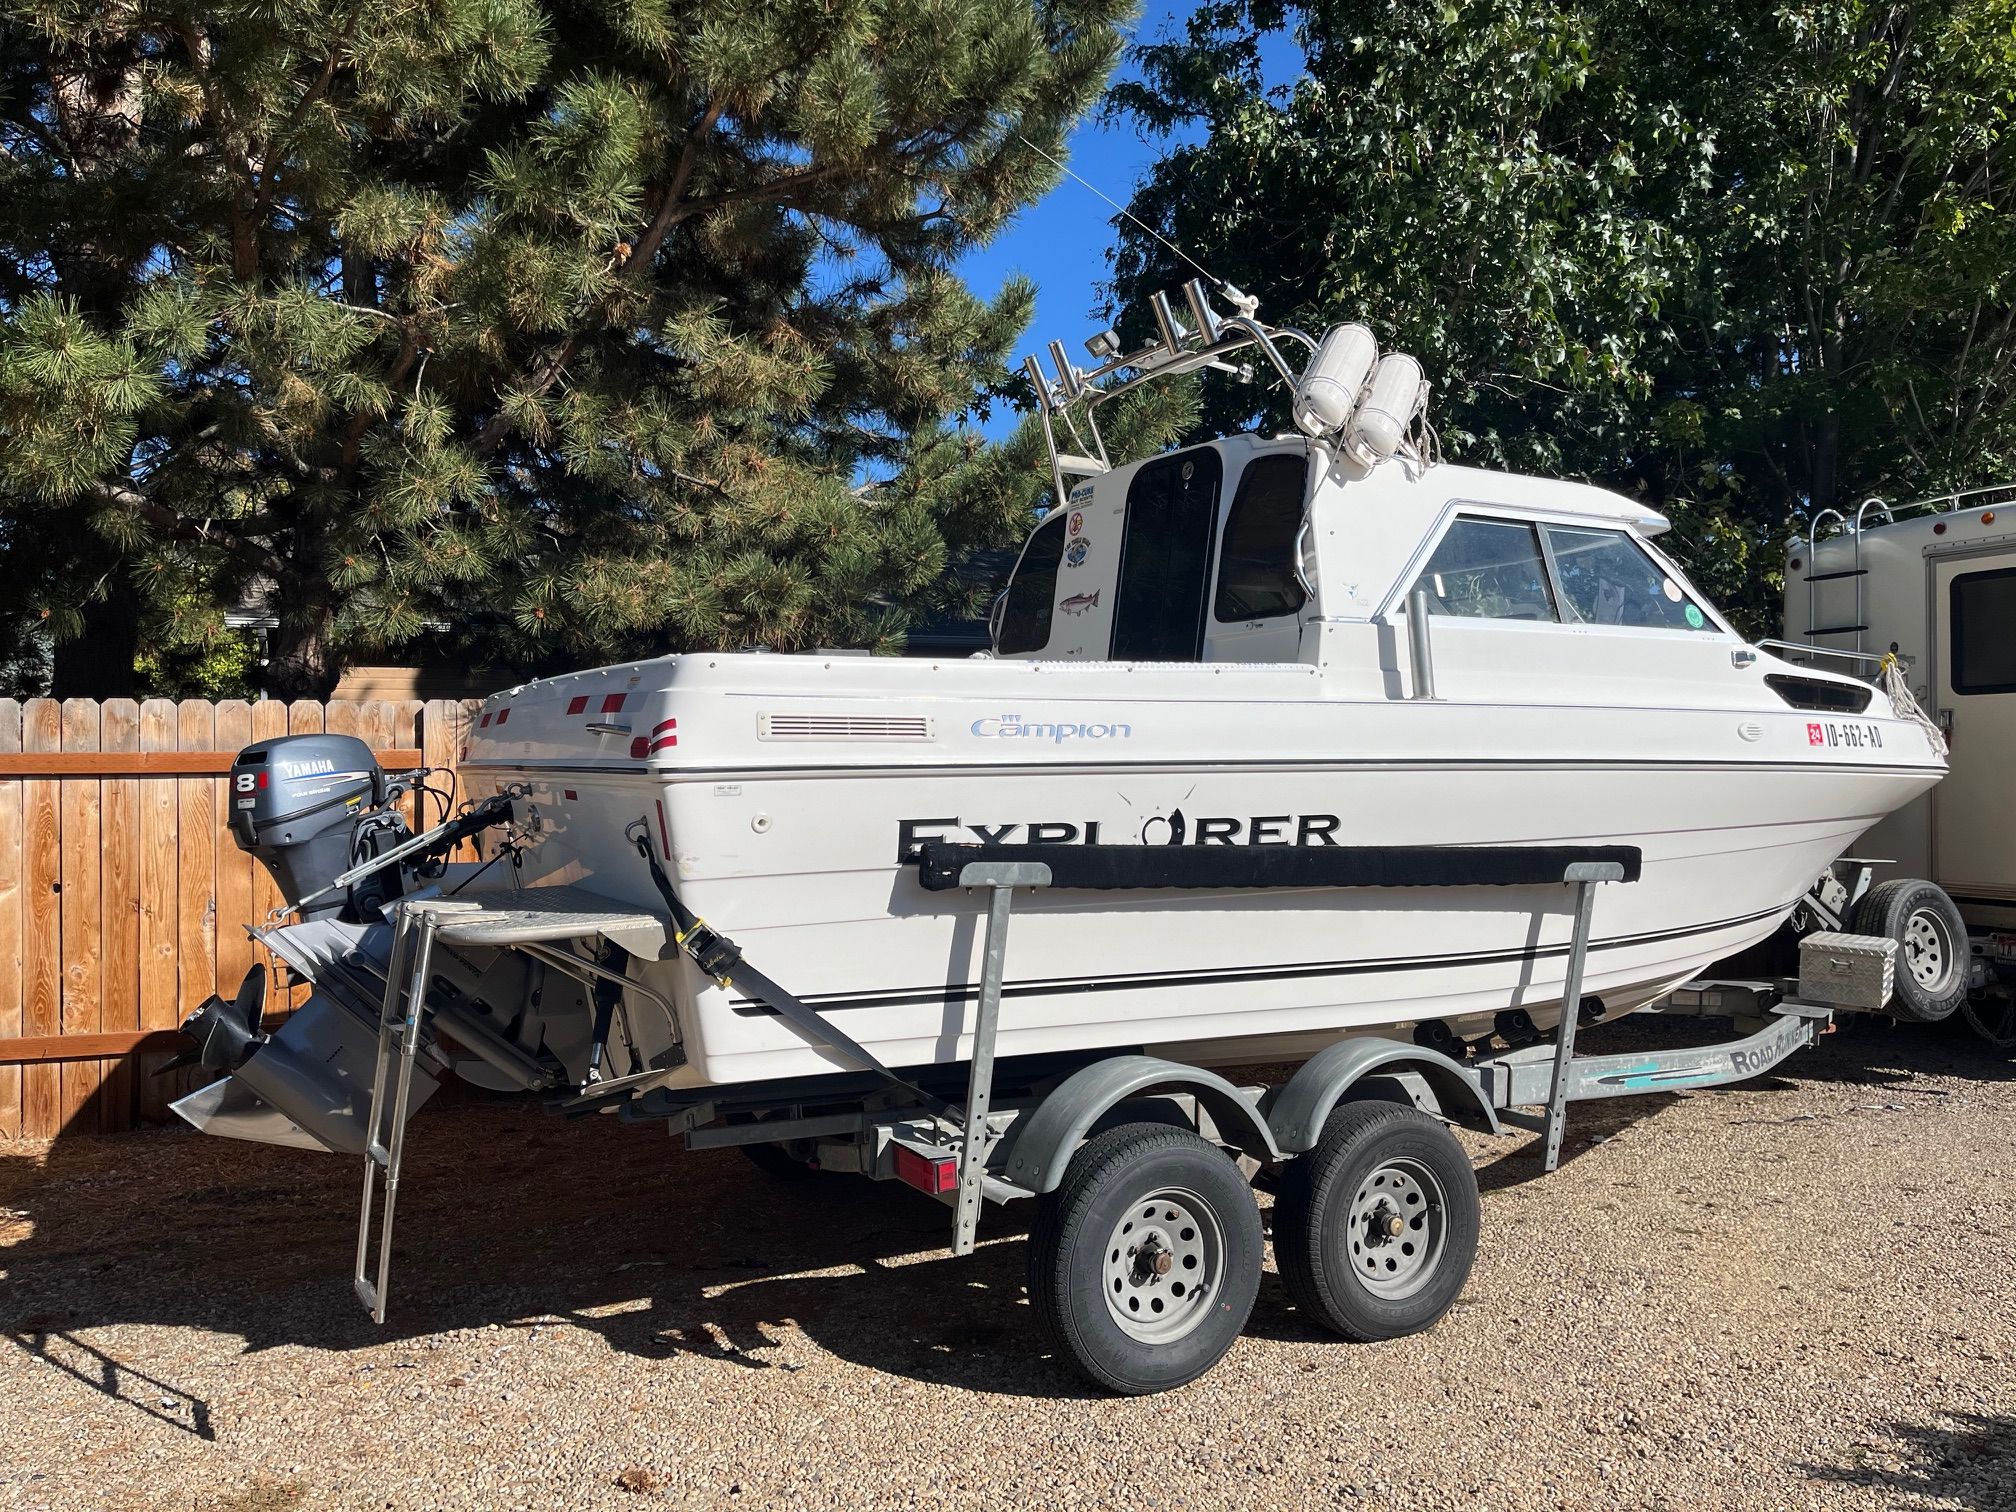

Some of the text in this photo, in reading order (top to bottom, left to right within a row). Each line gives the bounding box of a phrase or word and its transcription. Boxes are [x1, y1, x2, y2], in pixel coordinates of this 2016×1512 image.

[971, 715, 1132, 744] Campion
[1810, 729, 1820, 740] 24
[285, 760, 334, 777] YAMAHA
[237, 774, 255, 791] 8
[1729, 1045, 1774, 1075] ROAD
